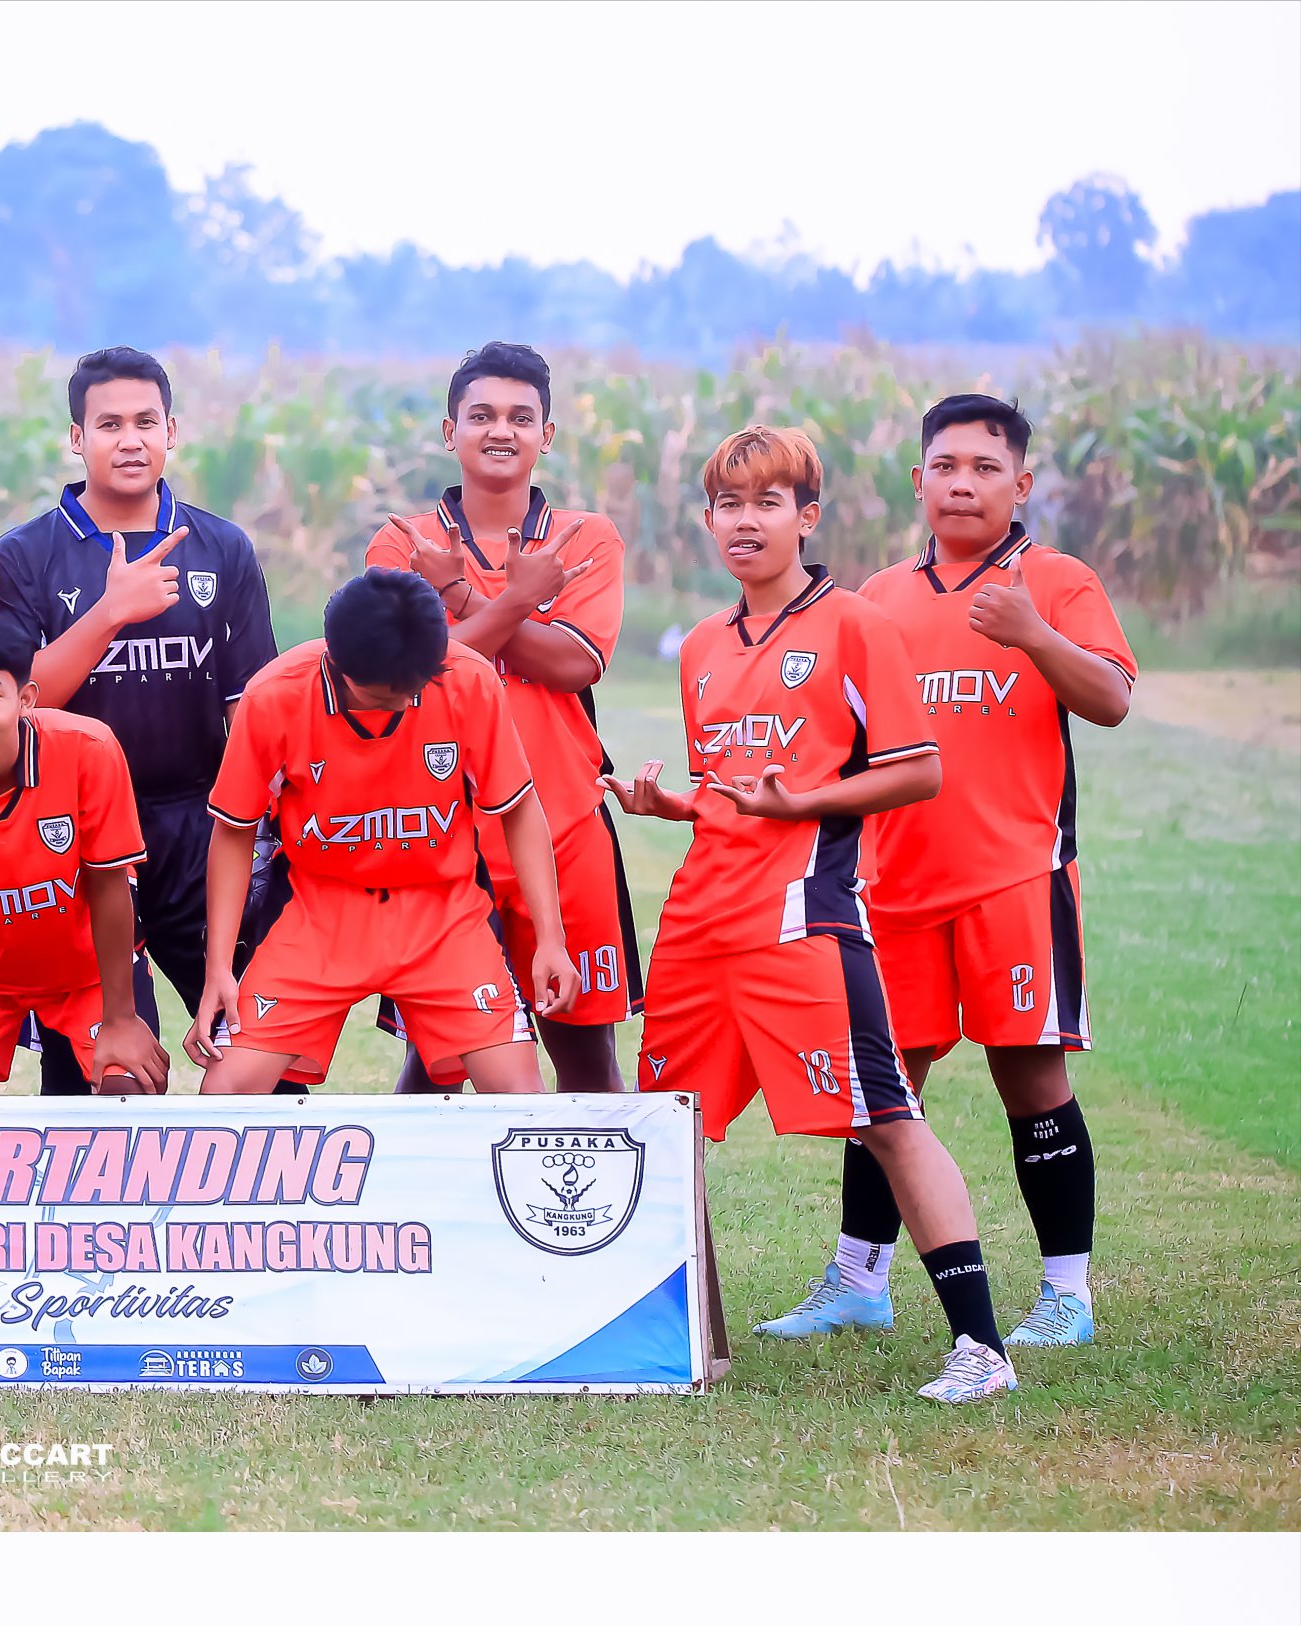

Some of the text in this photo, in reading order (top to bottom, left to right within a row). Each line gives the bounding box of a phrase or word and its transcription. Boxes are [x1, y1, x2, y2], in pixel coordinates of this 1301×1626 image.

[90, 636, 214, 674] ZMOV
[915, 669, 1020, 705] MOV
[928, 705, 1017, 717] AREL
[702, 749, 799, 765] PAREL
[303, 800, 460, 843] AZMOV
[297, 839, 438, 853] APPARE
[578, 944, 620, 995] 19
[521, 1137, 615, 1148] PUSAKA
[545, 1211, 594, 1221] KANGKUNG
[554, 1226, 586, 1237] 1963
[34, 1221, 160, 1273] DESA
[166, 1221, 432, 1274] KANGKUNG
[0, 1280, 234, 1330] Sportivitas
[40, 1347, 82, 1366] Titipan
[41, 1361, 82, 1379] Bapak
